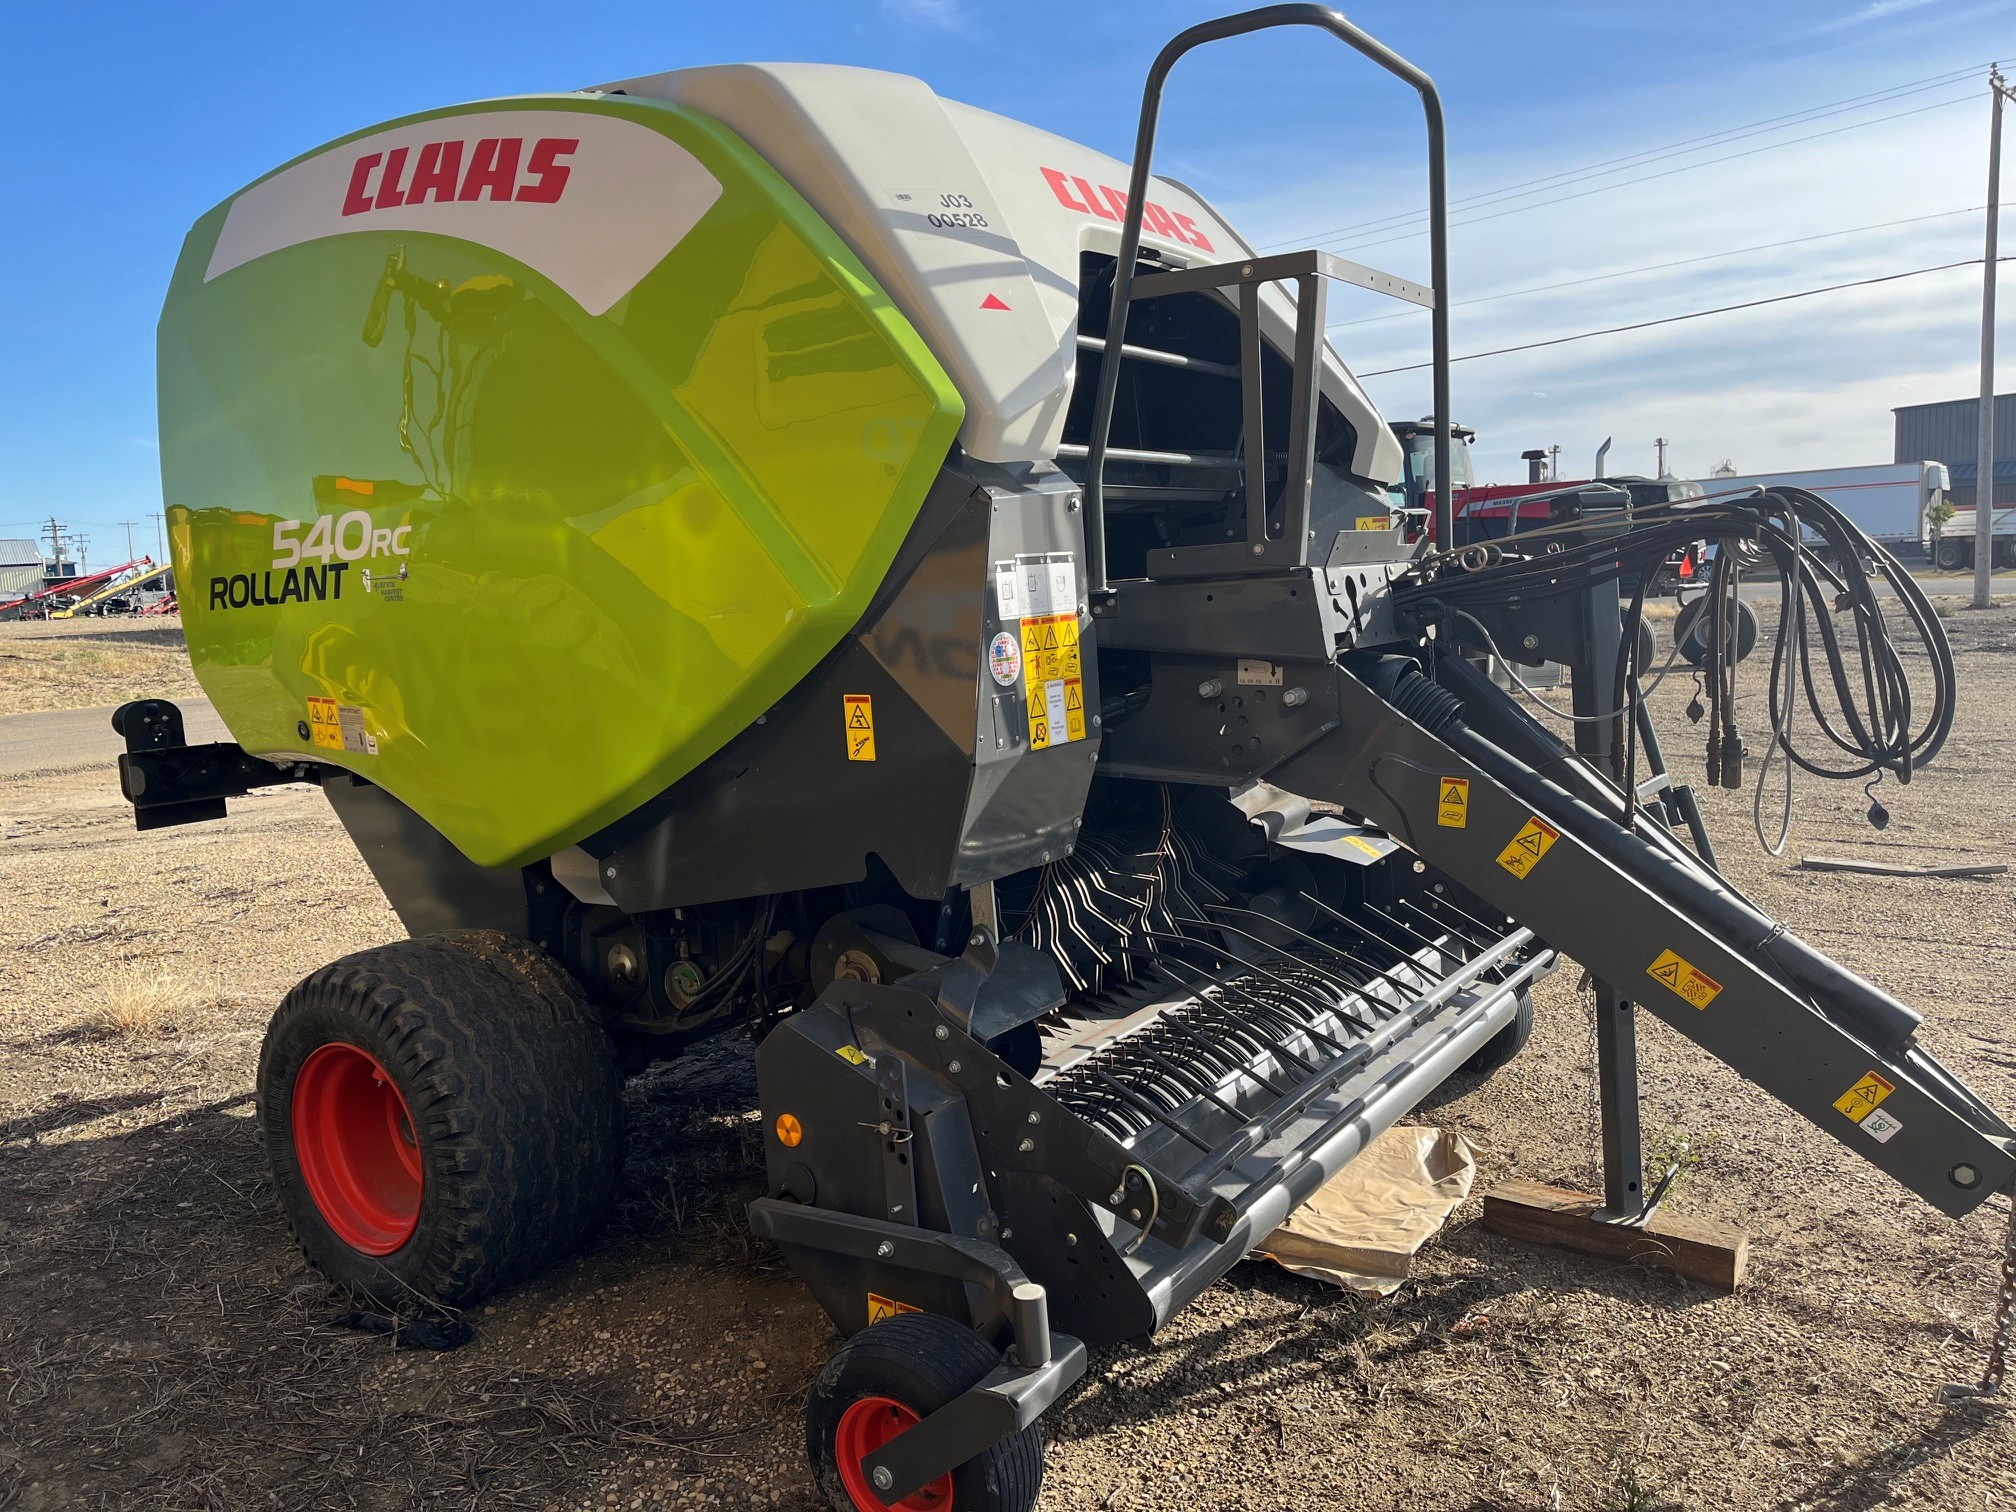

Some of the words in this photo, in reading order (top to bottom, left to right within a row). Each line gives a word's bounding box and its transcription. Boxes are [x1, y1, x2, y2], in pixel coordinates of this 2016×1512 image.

[341, 138, 580, 217] CLAAS
[927, 213, 988, 228] 00528
[1039, 166, 1215, 254] CLAAS
[210, 562, 349, 611] ROLLANT
